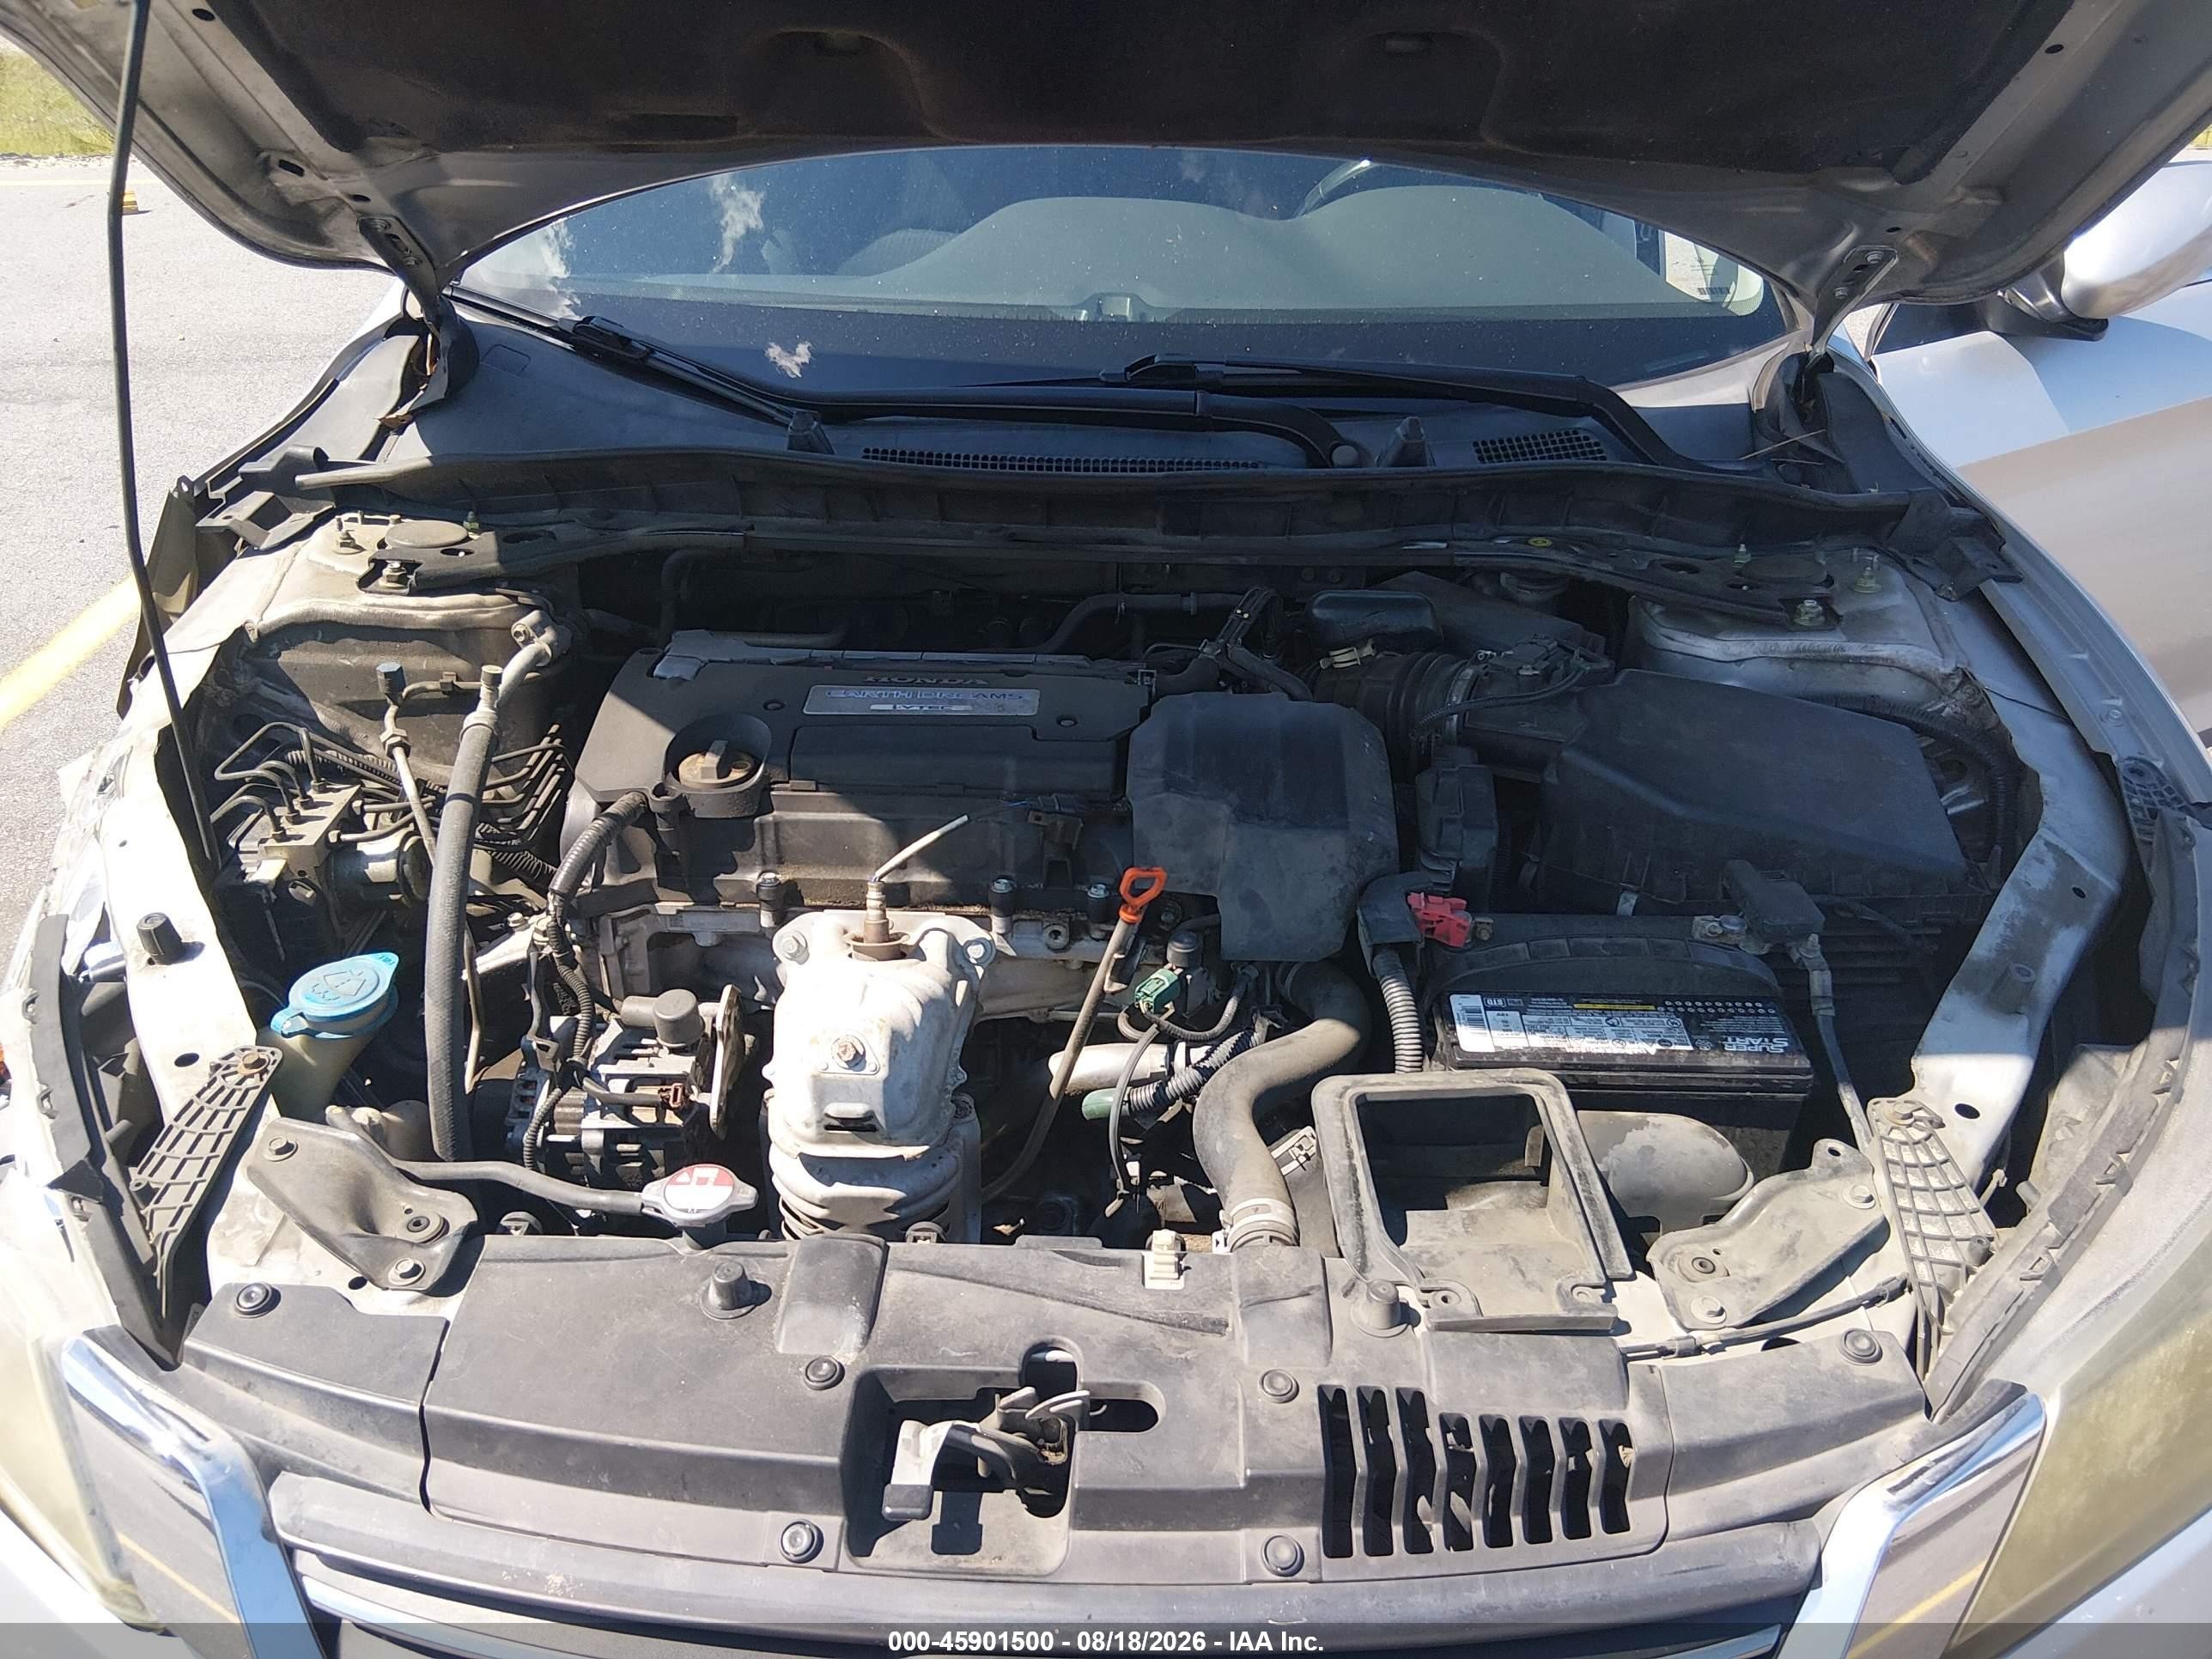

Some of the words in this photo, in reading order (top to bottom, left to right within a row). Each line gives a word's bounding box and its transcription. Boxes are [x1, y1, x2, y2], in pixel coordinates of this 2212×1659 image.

[865, 674, 989, 685] HONDA
[825, 690, 913, 699] EARTH
[917, 690, 1023, 700] DREAMS
[1723, 1036, 1789, 1047] START
[1723, 1043, 1784, 1054] SUPER
